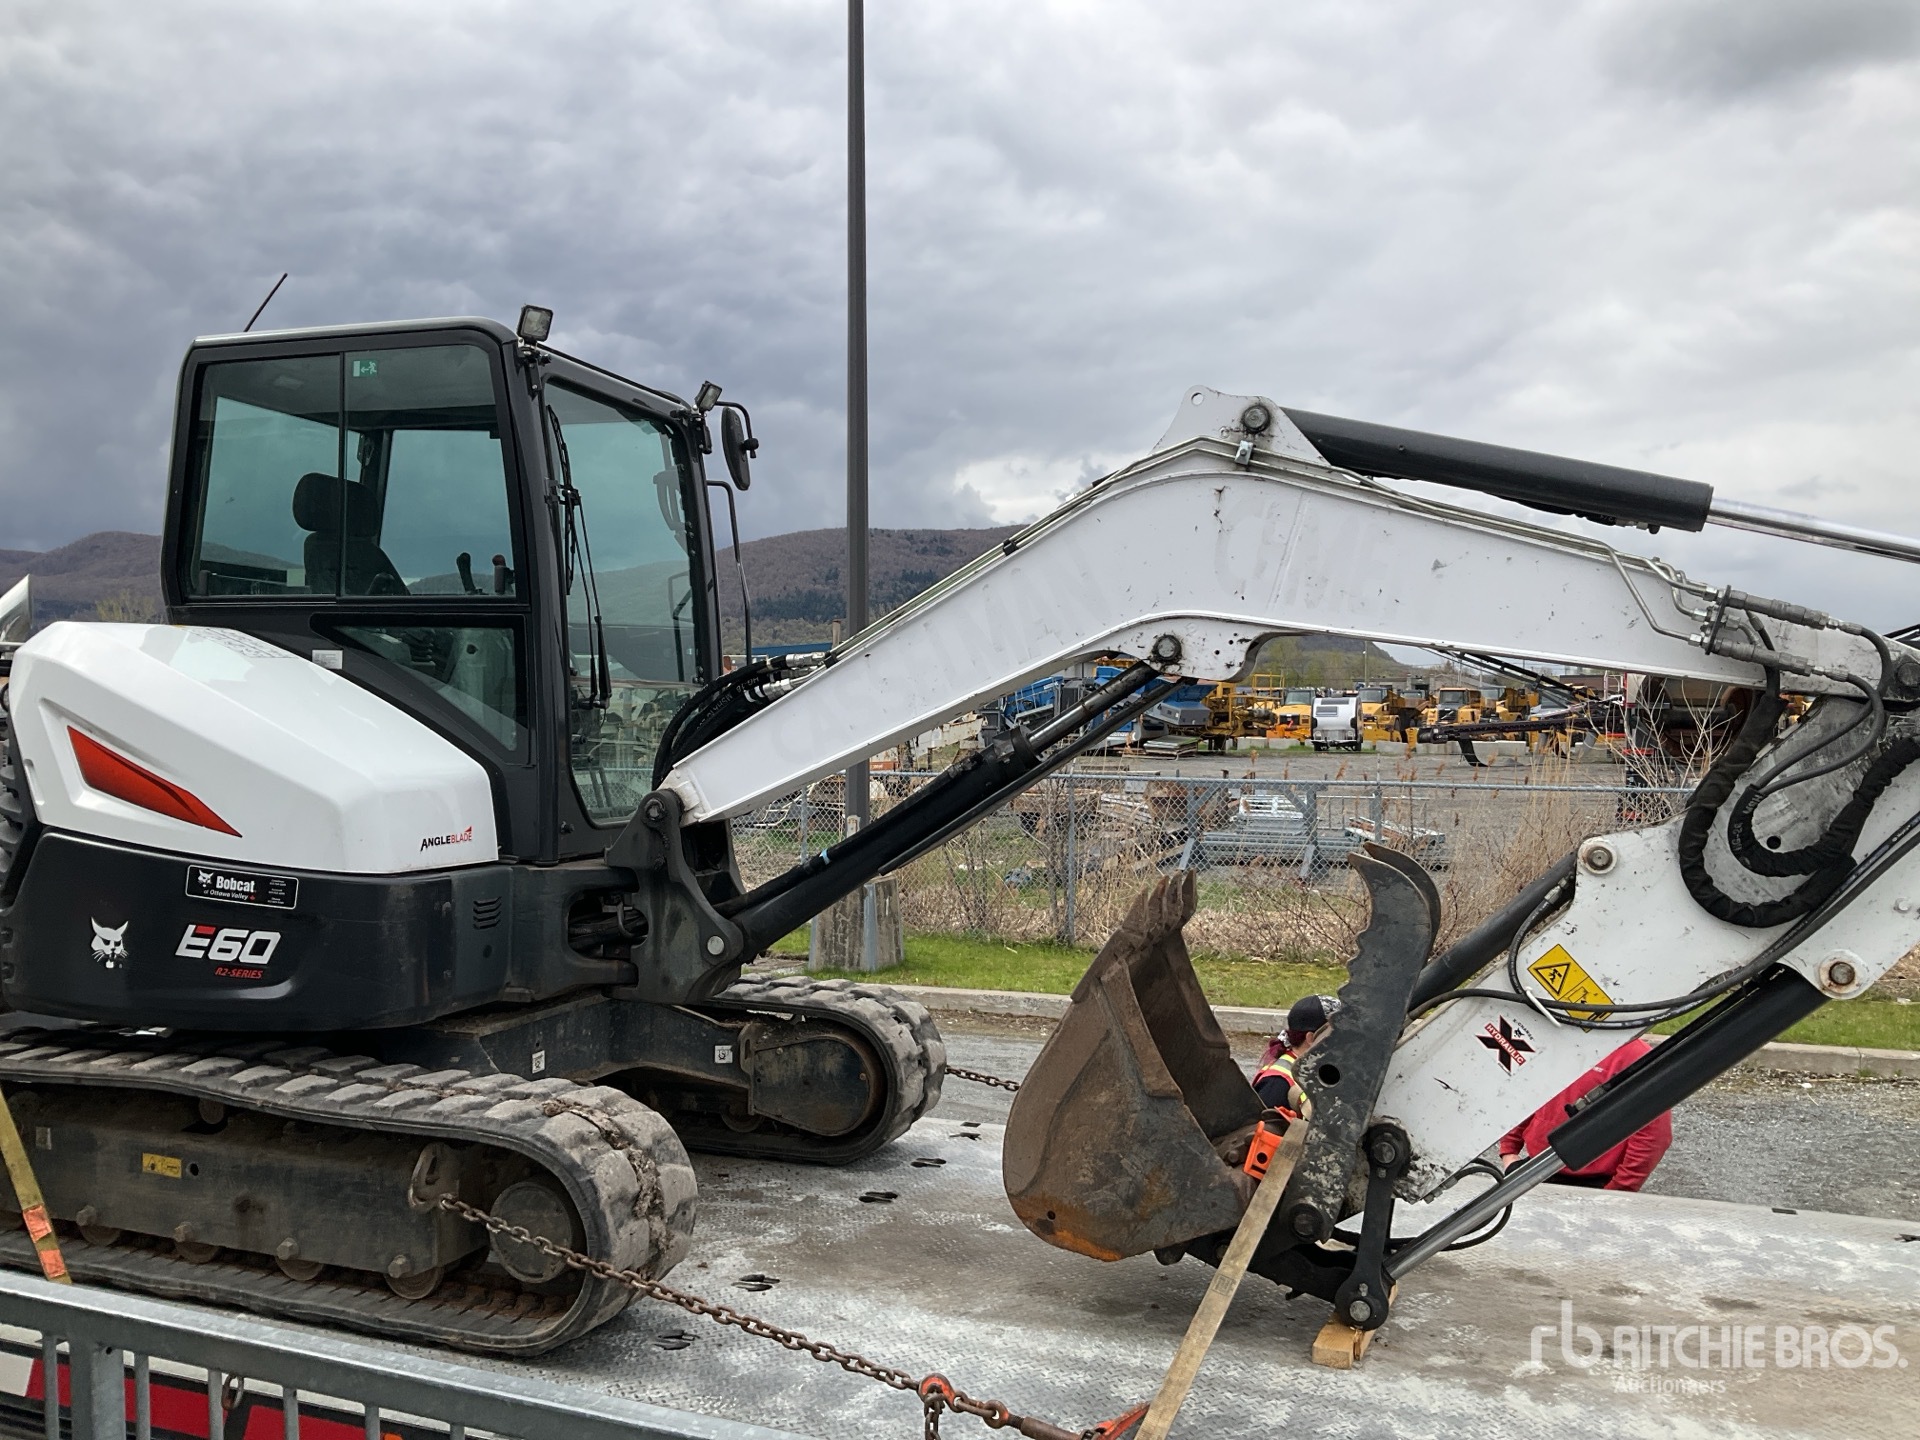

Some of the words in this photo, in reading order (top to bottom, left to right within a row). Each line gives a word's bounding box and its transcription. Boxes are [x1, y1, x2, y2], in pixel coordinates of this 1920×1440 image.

[420, 831, 472, 852] ANGLEBLADE
[216, 875, 255, 892] Bobcat
[209, 889, 231, 898] Ottawa
[231, 892, 248, 901] Valley
[175, 924, 282, 965] E60
[215, 967, 264, 979] R2-SERIES
[1486, 1024, 1525, 1064] HYDRAULIC
